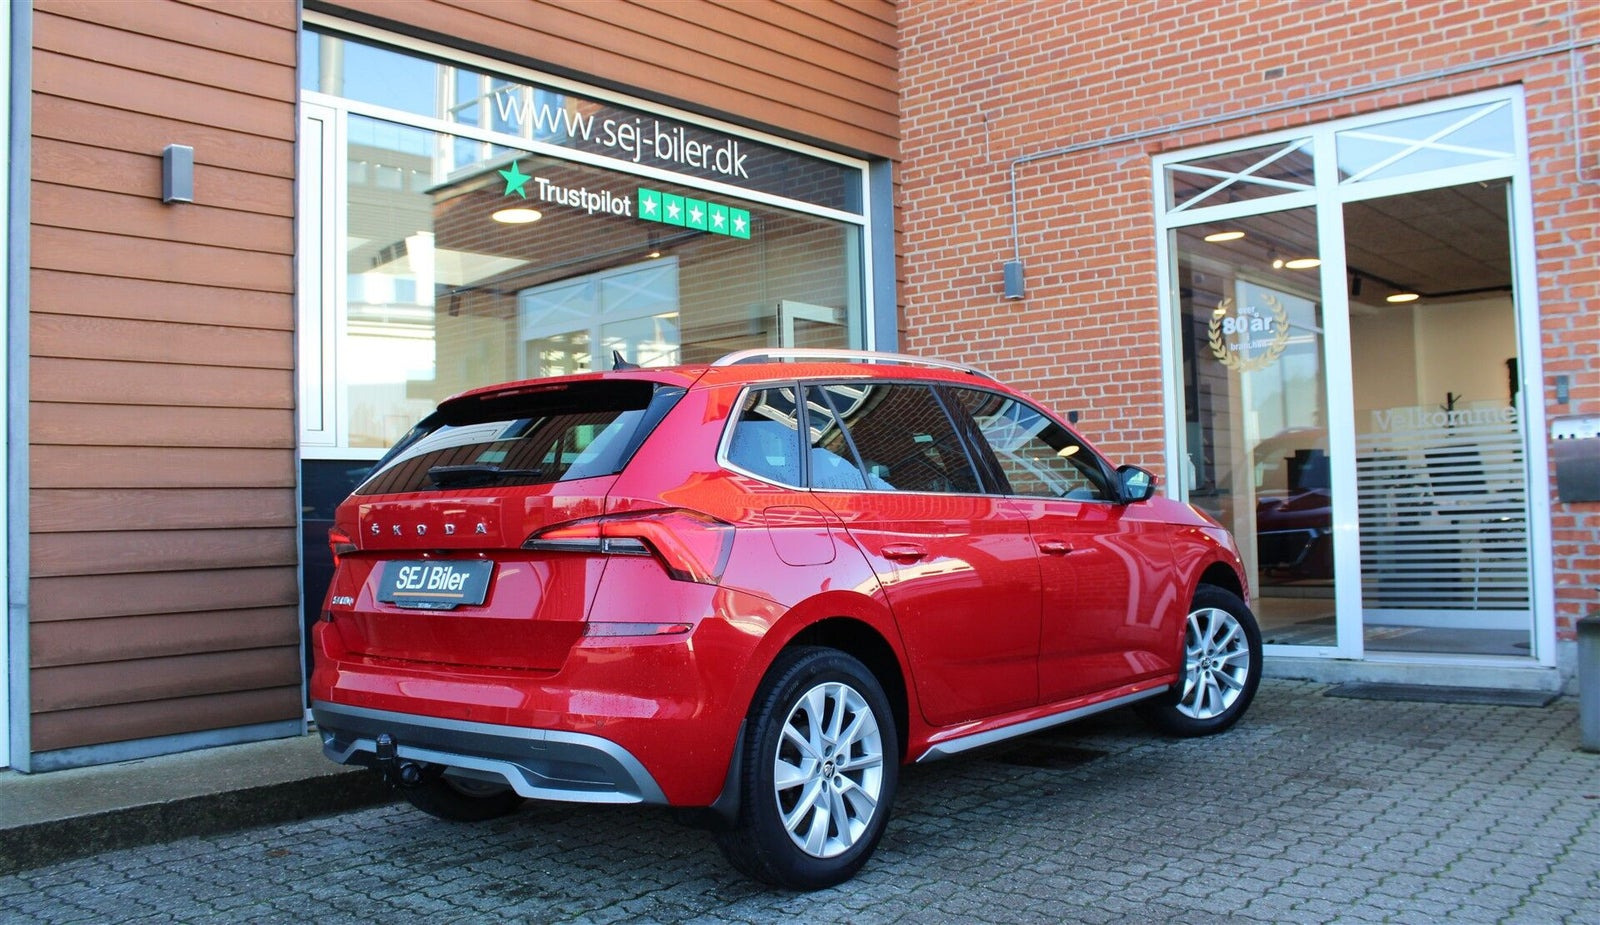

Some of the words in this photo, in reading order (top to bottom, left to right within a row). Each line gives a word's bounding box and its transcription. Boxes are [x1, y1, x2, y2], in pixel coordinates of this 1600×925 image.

[495, 91, 749, 179] www.sej-biler.dk
[534, 176, 632, 217] Trustpilot
[1222, 315, 1248, 335] 80
[1250, 311, 1273, 331] år
[396, 565, 429, 590] SEJ
[427, 565, 470, 591] Biler
